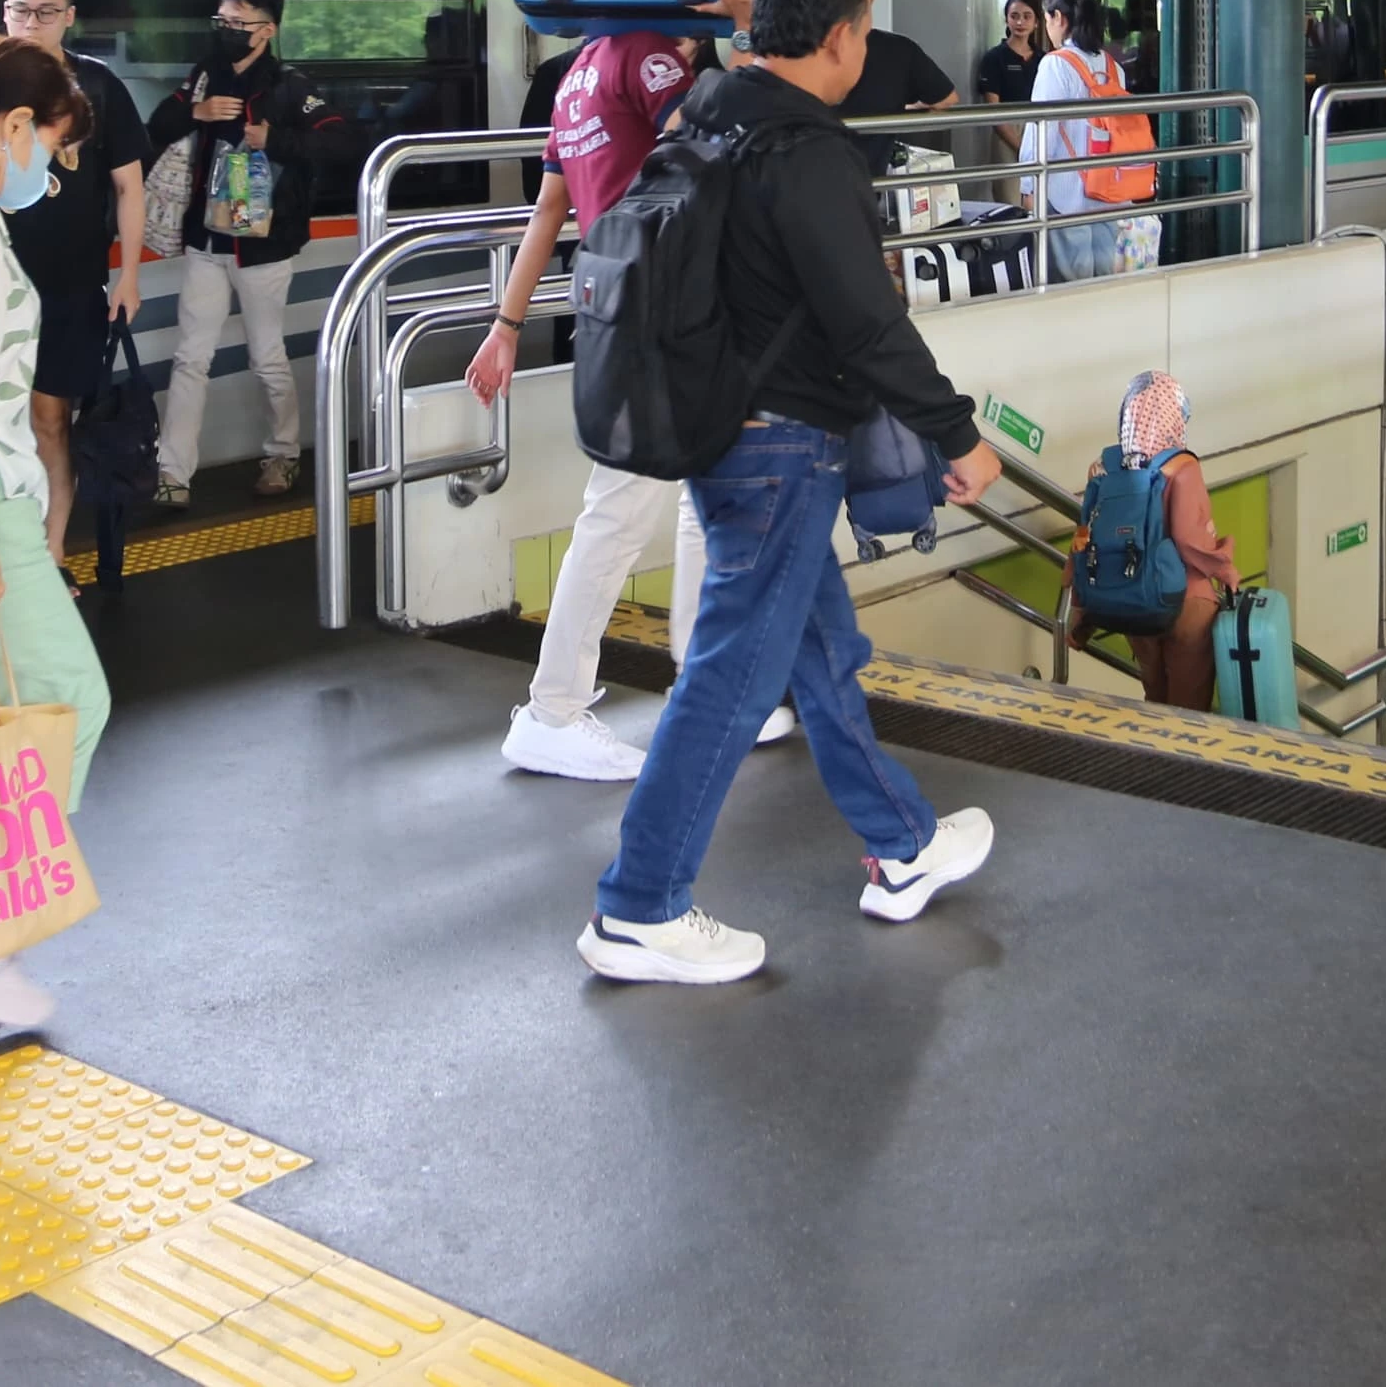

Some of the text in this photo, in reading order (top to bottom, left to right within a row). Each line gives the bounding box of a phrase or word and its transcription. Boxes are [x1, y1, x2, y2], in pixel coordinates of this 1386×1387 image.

[916, 681, 1108, 724] LANGKAH
[1114, 720, 1223, 747] KAKI
[1229, 745, 1351, 774] ANDA
